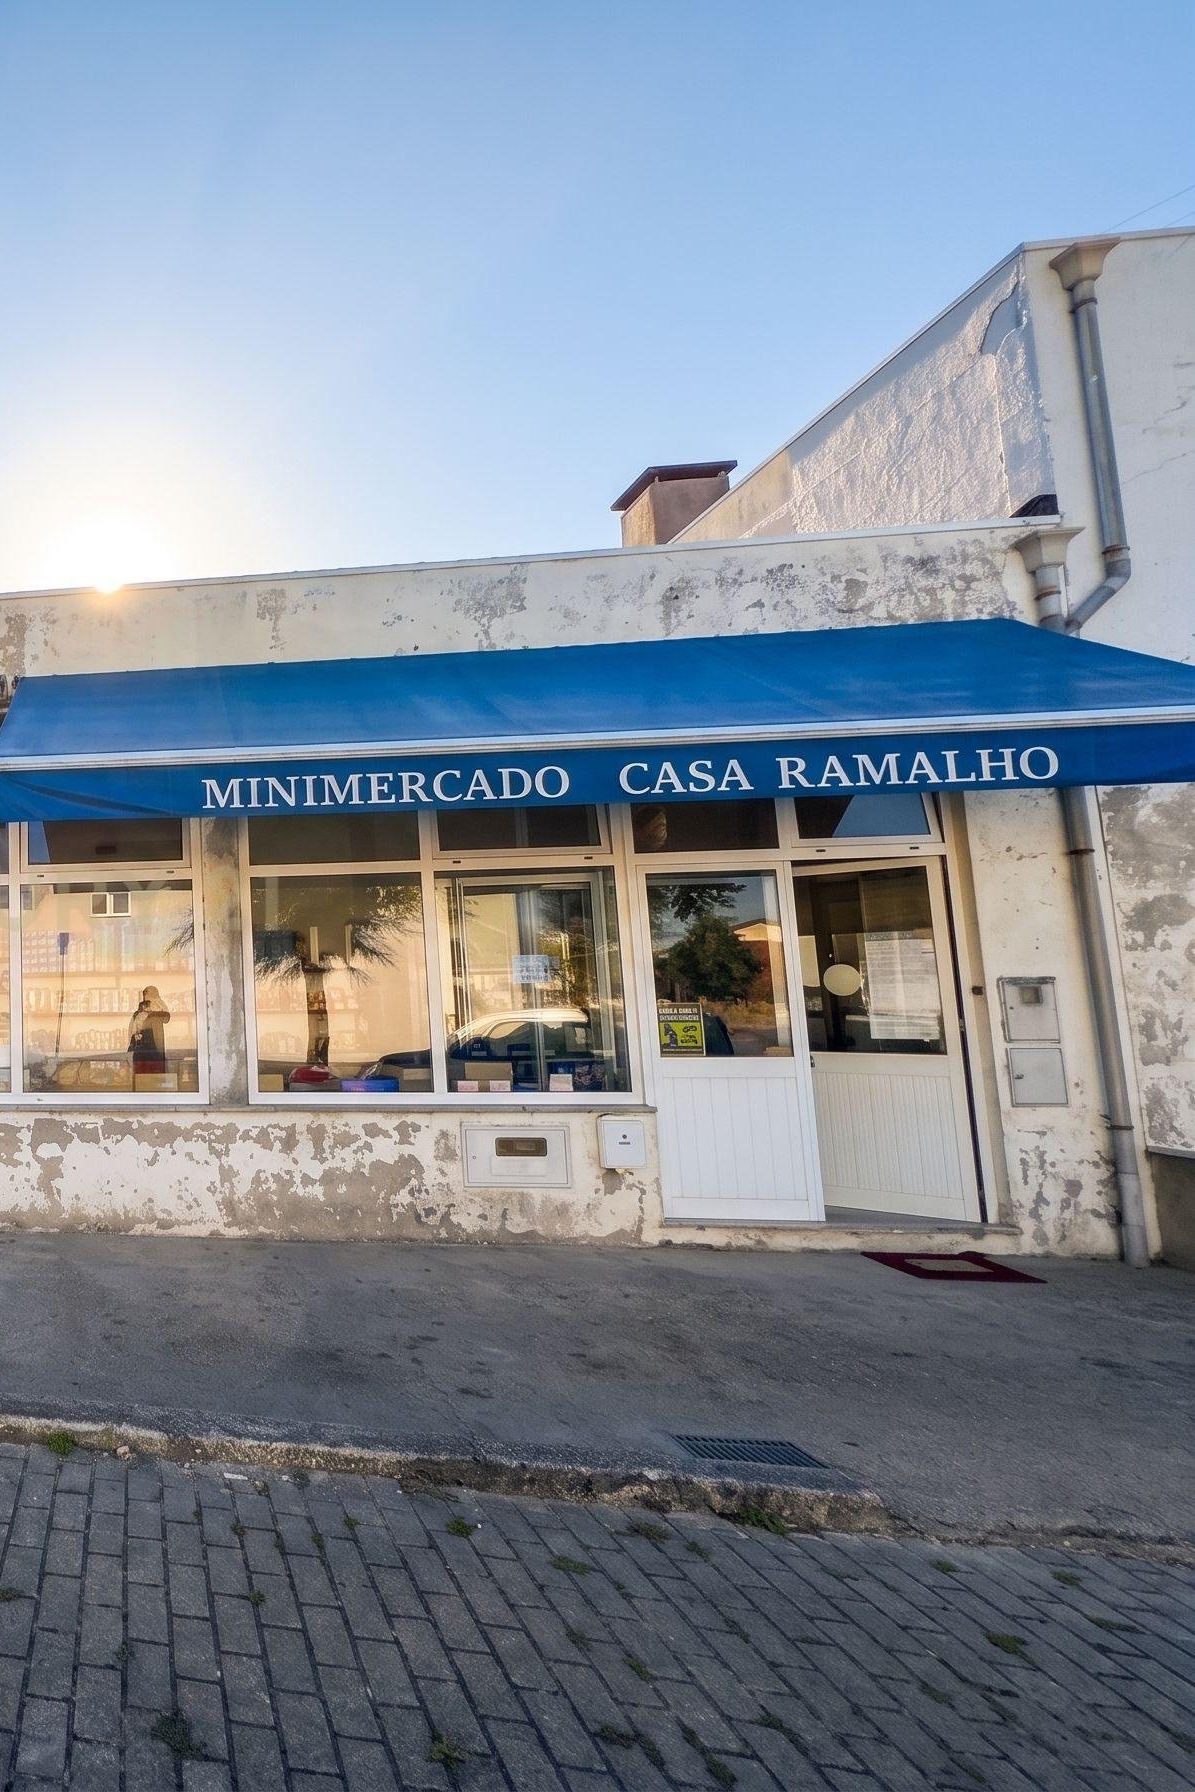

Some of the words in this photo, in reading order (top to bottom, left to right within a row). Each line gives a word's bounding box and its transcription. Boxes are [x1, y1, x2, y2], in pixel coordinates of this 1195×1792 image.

[201, 765, 571, 810] MINIMERCADO
[618, 758, 755, 796] CASA
[775, 745, 1061, 790] RAMALHO
